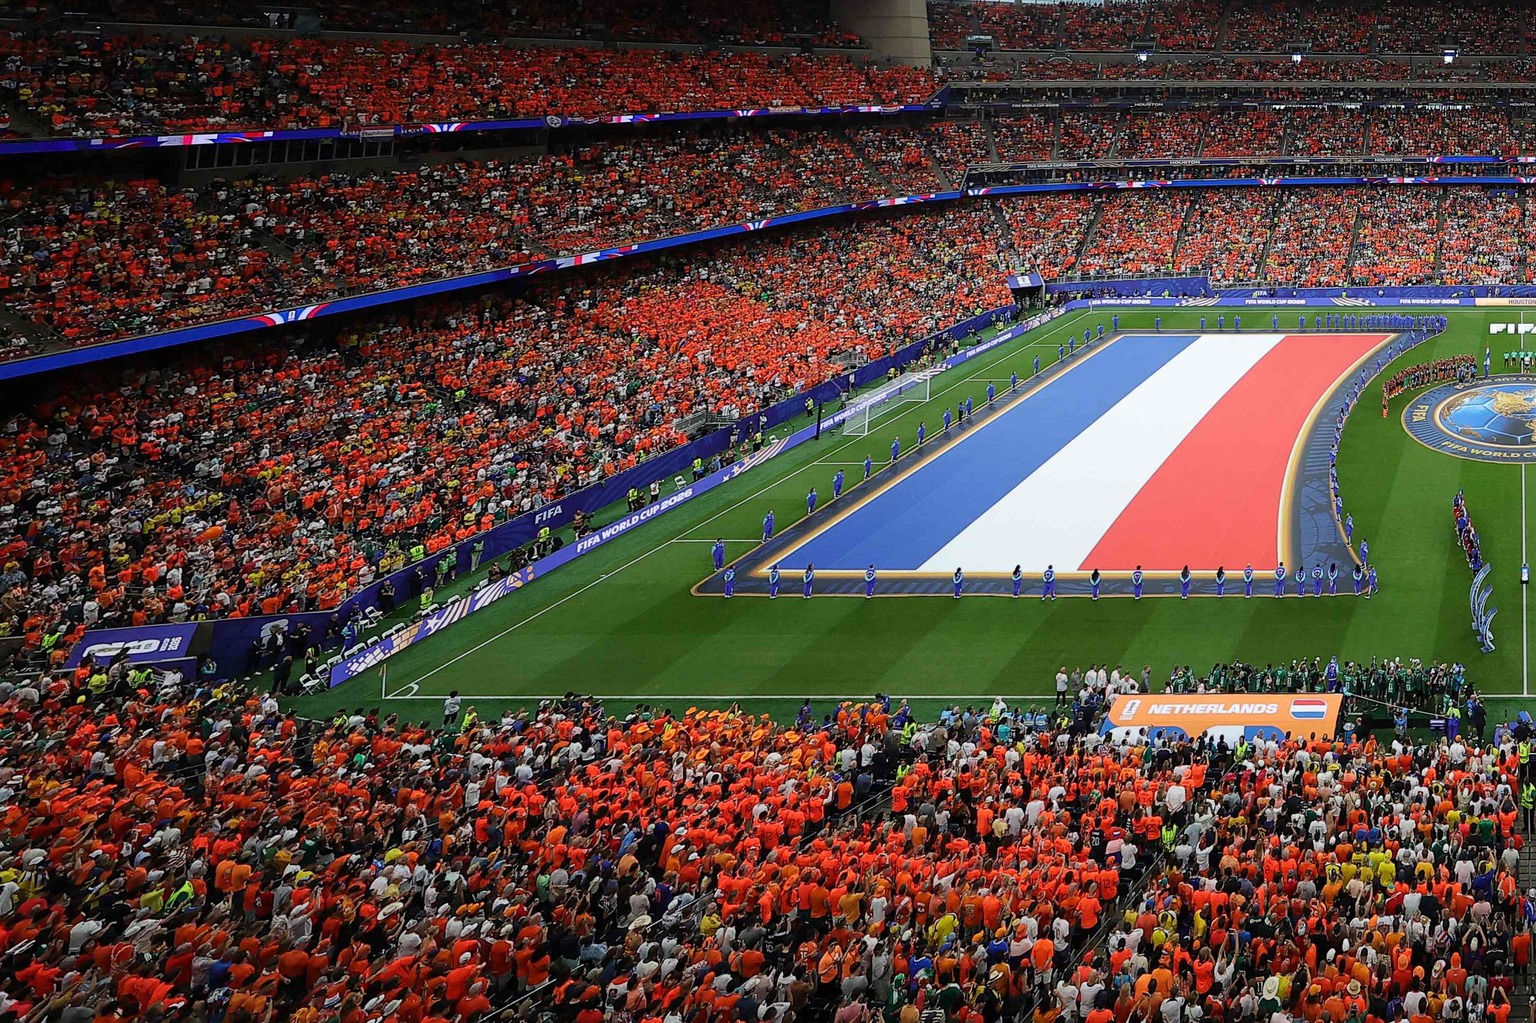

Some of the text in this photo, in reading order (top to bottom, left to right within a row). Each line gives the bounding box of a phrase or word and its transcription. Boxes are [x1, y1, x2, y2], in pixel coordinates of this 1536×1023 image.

[820, 419, 834, 430] FIFA
[833, 408, 856, 424] WORLD
[855, 401, 869, 413] CUP
[1411, 404, 1430, 422] FIFA
[1440, 440, 1468, 454] FIFA
[1470, 448, 1523, 459] WORLD
[534, 505, 563, 525] FIFA
[576, 488, 693, 553] FIFA WORLD CUP 2026
[1147, 703, 1279, 715] NETHERLANDS
